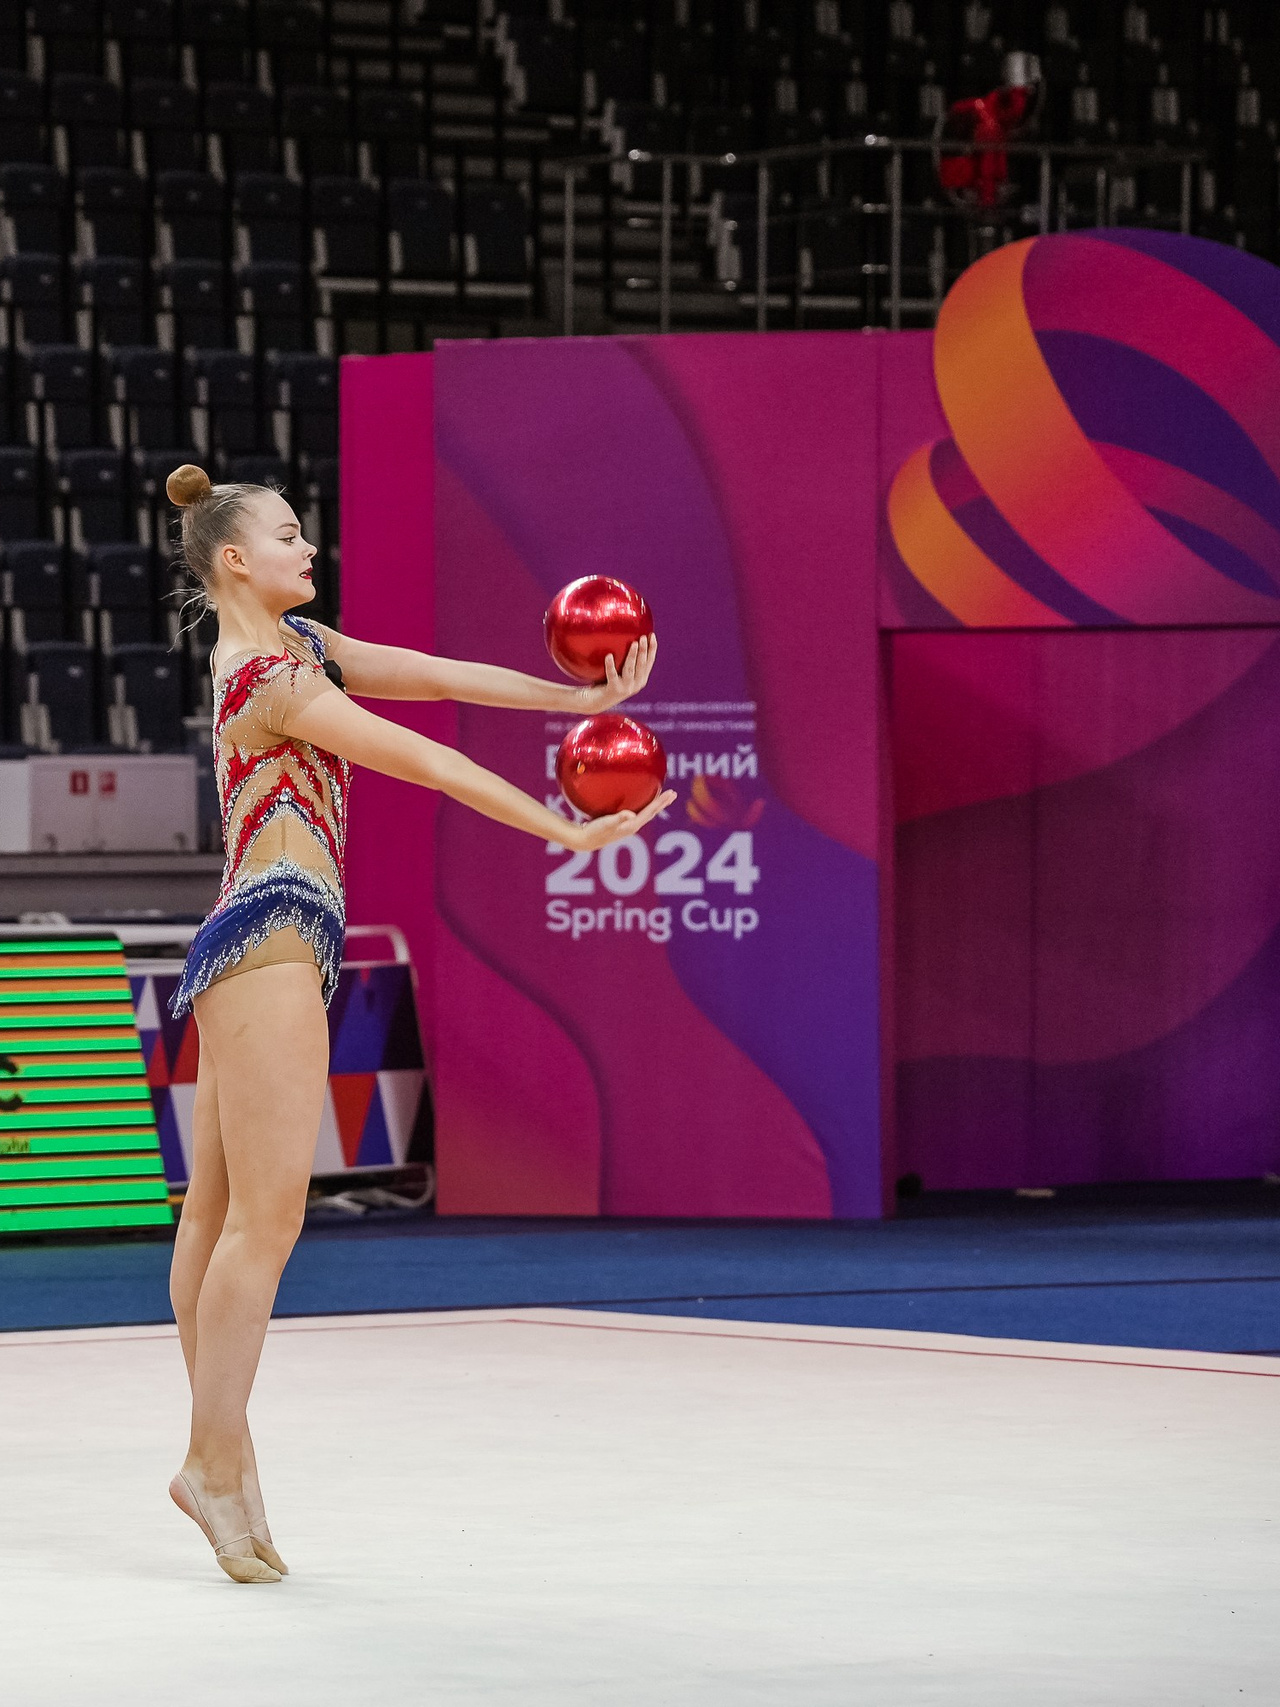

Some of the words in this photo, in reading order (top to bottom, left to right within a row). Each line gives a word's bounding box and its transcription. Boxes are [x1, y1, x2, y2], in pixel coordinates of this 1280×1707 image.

[545, 830, 761, 895] 2024
[545, 899, 672, 943] Spring
[681, 899, 759, 940] Cup
